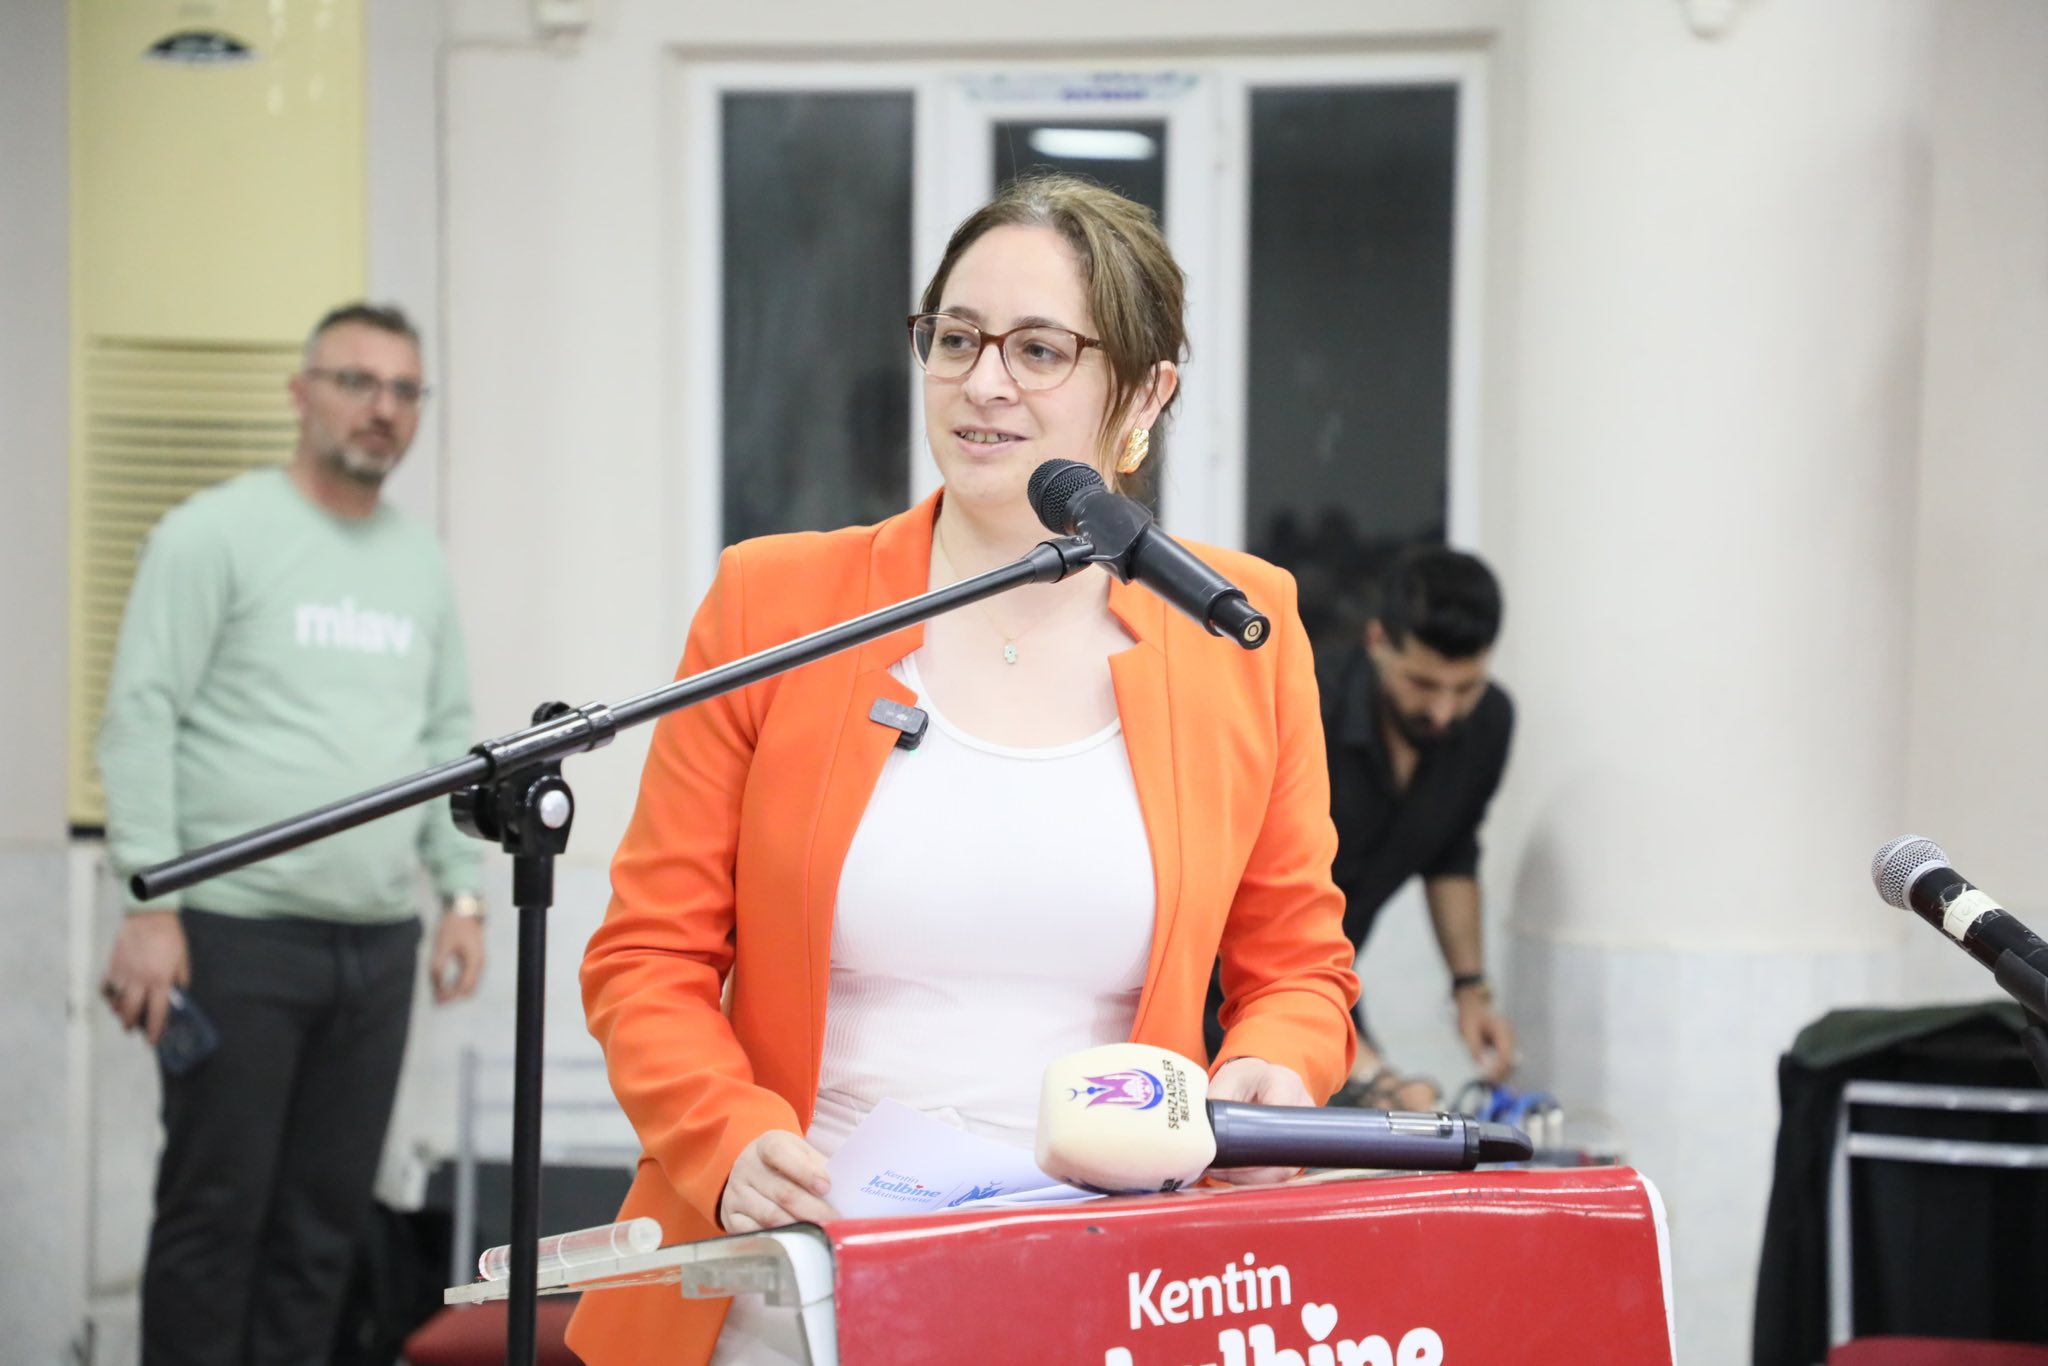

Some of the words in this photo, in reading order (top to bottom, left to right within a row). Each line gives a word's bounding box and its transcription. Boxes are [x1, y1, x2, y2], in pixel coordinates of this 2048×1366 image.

[869, 1175, 942, 1198] kalbine
[883, 1169, 920, 1184] Kentin
[1128, 1252, 1292, 1330] Kentin
[1104, 1303, 1444, 1366] lbine
